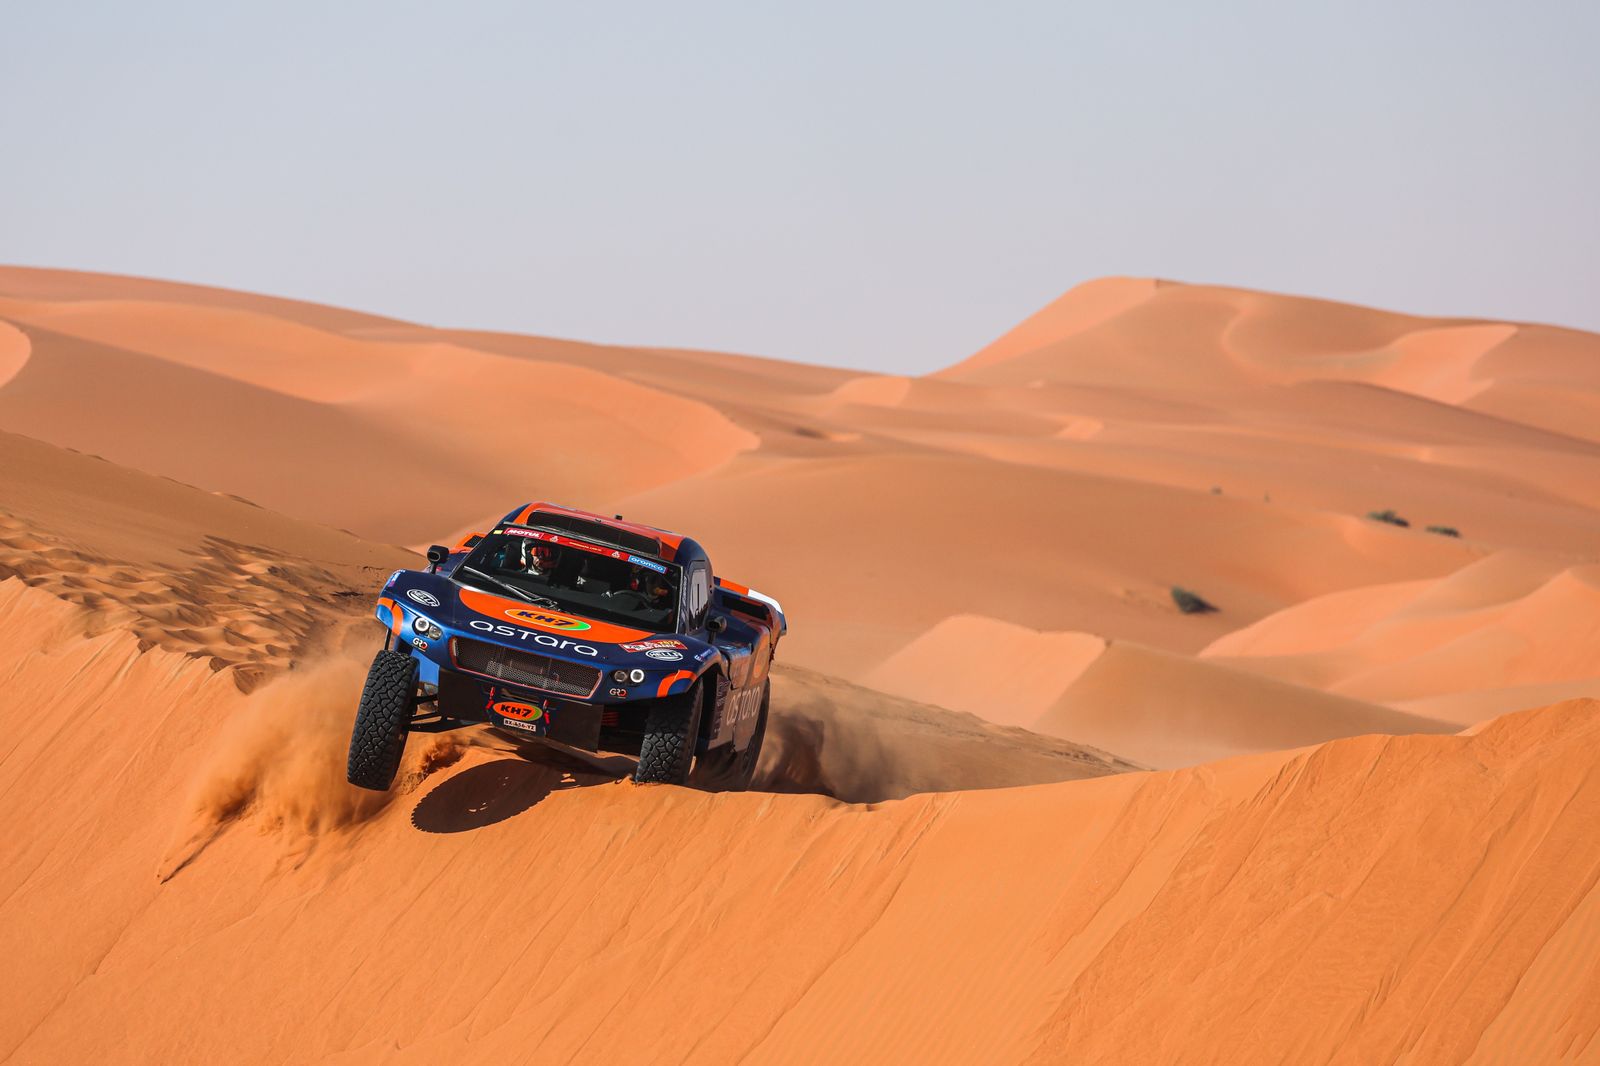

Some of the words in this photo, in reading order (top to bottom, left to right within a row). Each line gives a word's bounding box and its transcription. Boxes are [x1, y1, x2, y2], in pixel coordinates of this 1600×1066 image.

[508, 529, 540, 538] MOTUL
[630, 556, 665, 572] aramco
[469, 620, 599, 657] astara
[647, 649, 682, 660] HELLA
